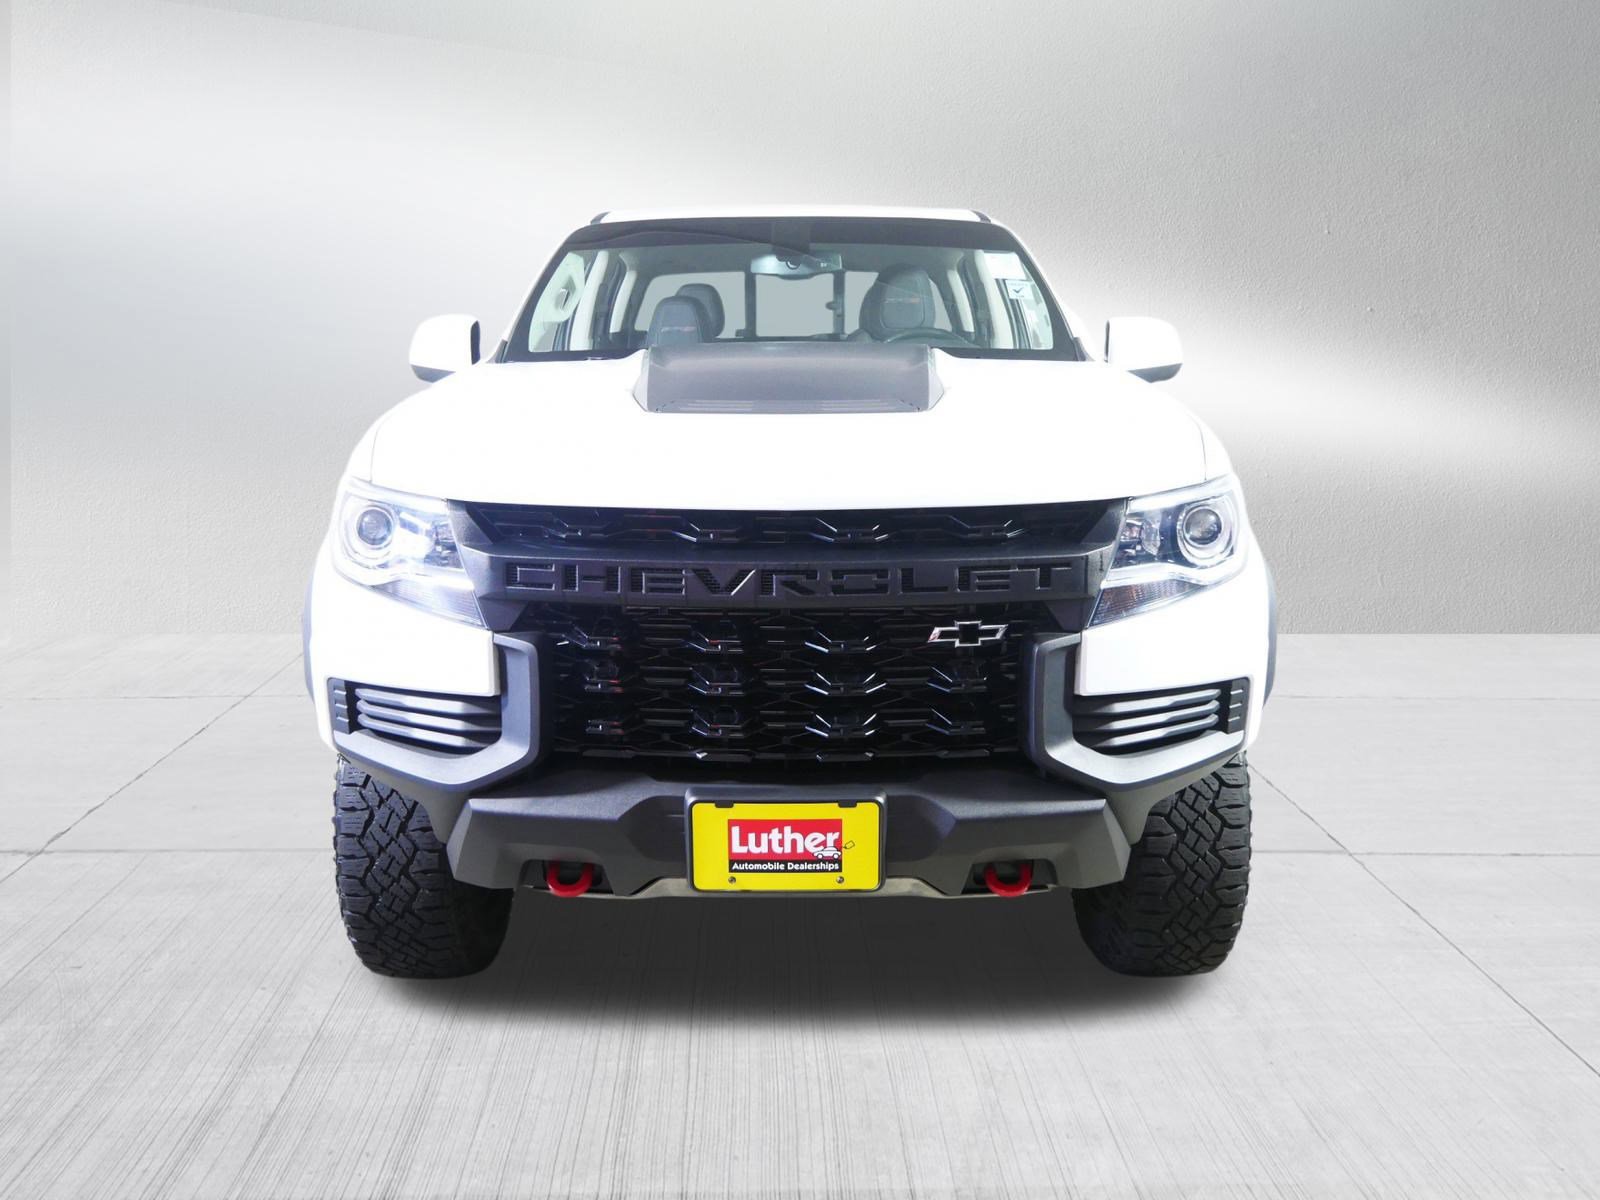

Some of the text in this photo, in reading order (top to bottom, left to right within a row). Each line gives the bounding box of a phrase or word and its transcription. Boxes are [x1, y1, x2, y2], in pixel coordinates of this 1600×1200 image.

[505, 562, 1073, 597] CHEVROLET
[731, 826, 840, 853] Luther
[732, 861, 840, 871] Automobile Dealerships
